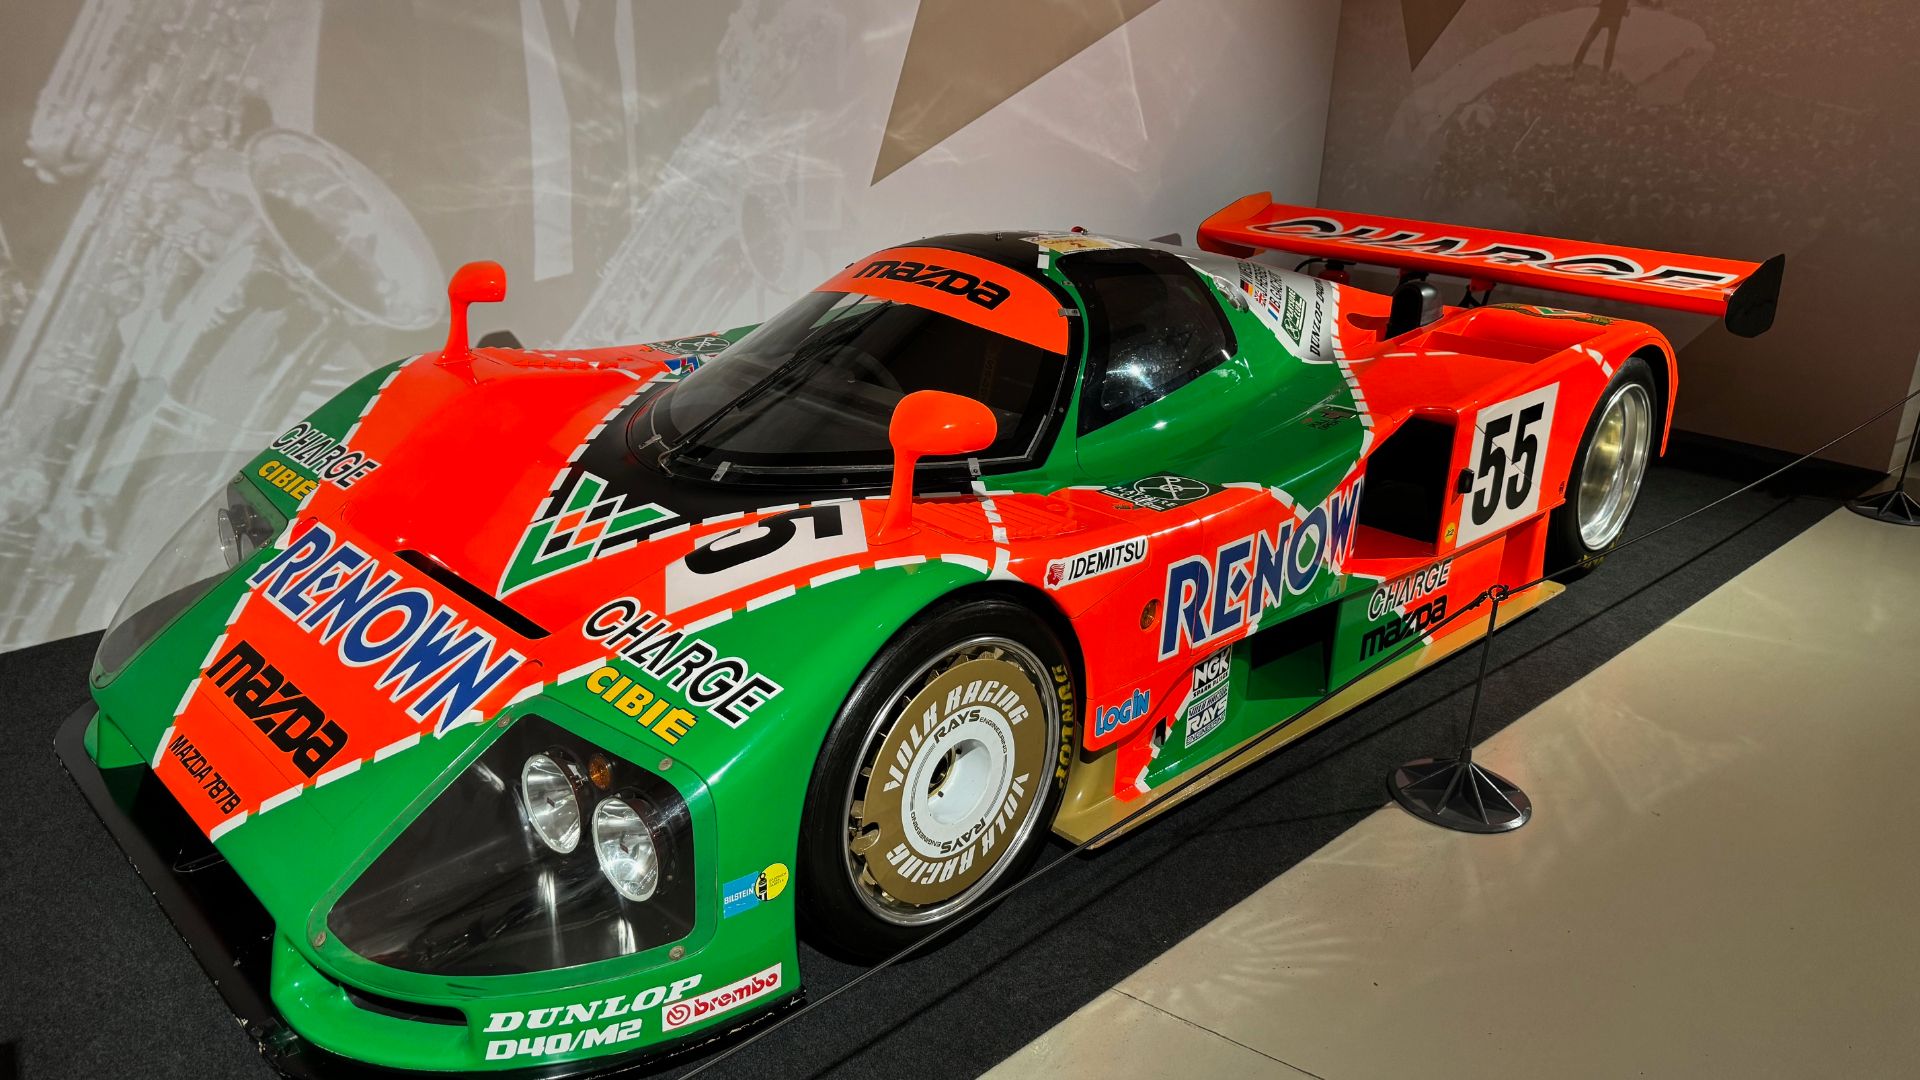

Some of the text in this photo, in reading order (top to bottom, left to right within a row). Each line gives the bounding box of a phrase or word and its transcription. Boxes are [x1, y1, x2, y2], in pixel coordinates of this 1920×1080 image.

[1249, 217, 1738, 290] CHARGE
[1310, 301, 1324, 357] DUNLOP
[258, 460, 319, 501] CIBIÉ
[270, 422, 382, 490] CHARGE
[1471, 402, 1545, 526] 55
[1069, 539, 1146, 581] IDEMITSU
[1158, 474, 1365, 663] RENOW
[1368, 557, 1454, 622] CHARGE
[247, 522, 525, 739] RENOWN
[581, 597, 784, 729] CHARGE
[1193, 682, 1212, 699] SPARK
[1194, 648, 1230, 690] NGK
[586, 666, 699, 746] CIBIÉ
[883, 680, 1029, 792] VOLK RACING
[933, 709, 1008, 754] RAYS ENGINEERING
[1187, 698, 1227, 737] RAYS
[168, 734, 242, 815] MAZDA 787B
[886, 773, 1030, 885] VOLK RACING
[910, 811, 986, 855] RAYS ENGINEERING
[724, 887, 755, 905] BILSTEIN
[483, 973, 703, 1033] DUNLOP
[693, 971, 779, 1017] brembo
[485, 1018, 643, 1061] D40/M2
